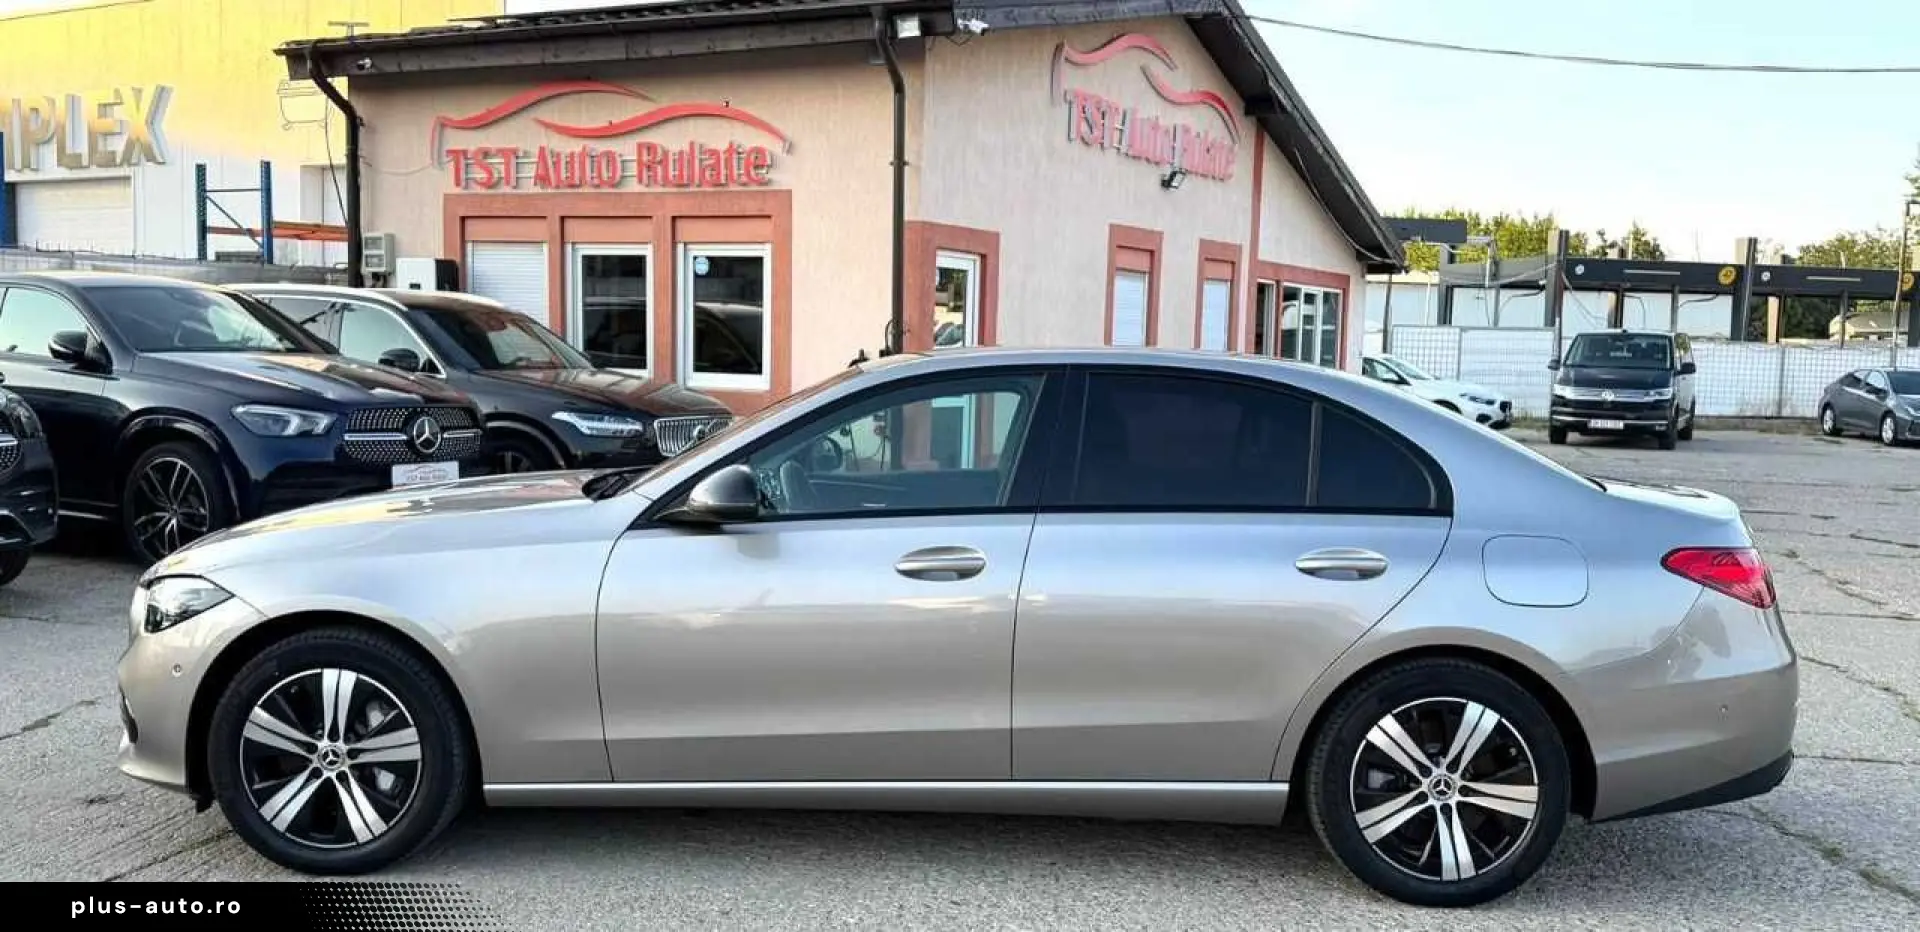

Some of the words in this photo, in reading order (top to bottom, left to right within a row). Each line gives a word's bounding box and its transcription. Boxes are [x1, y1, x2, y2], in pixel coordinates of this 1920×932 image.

[1065, 90, 1121, 153] TST
[446, 148, 519, 189] TST
[533, 146, 622, 188] Auto
[635, 141, 777, 188] Rulate
